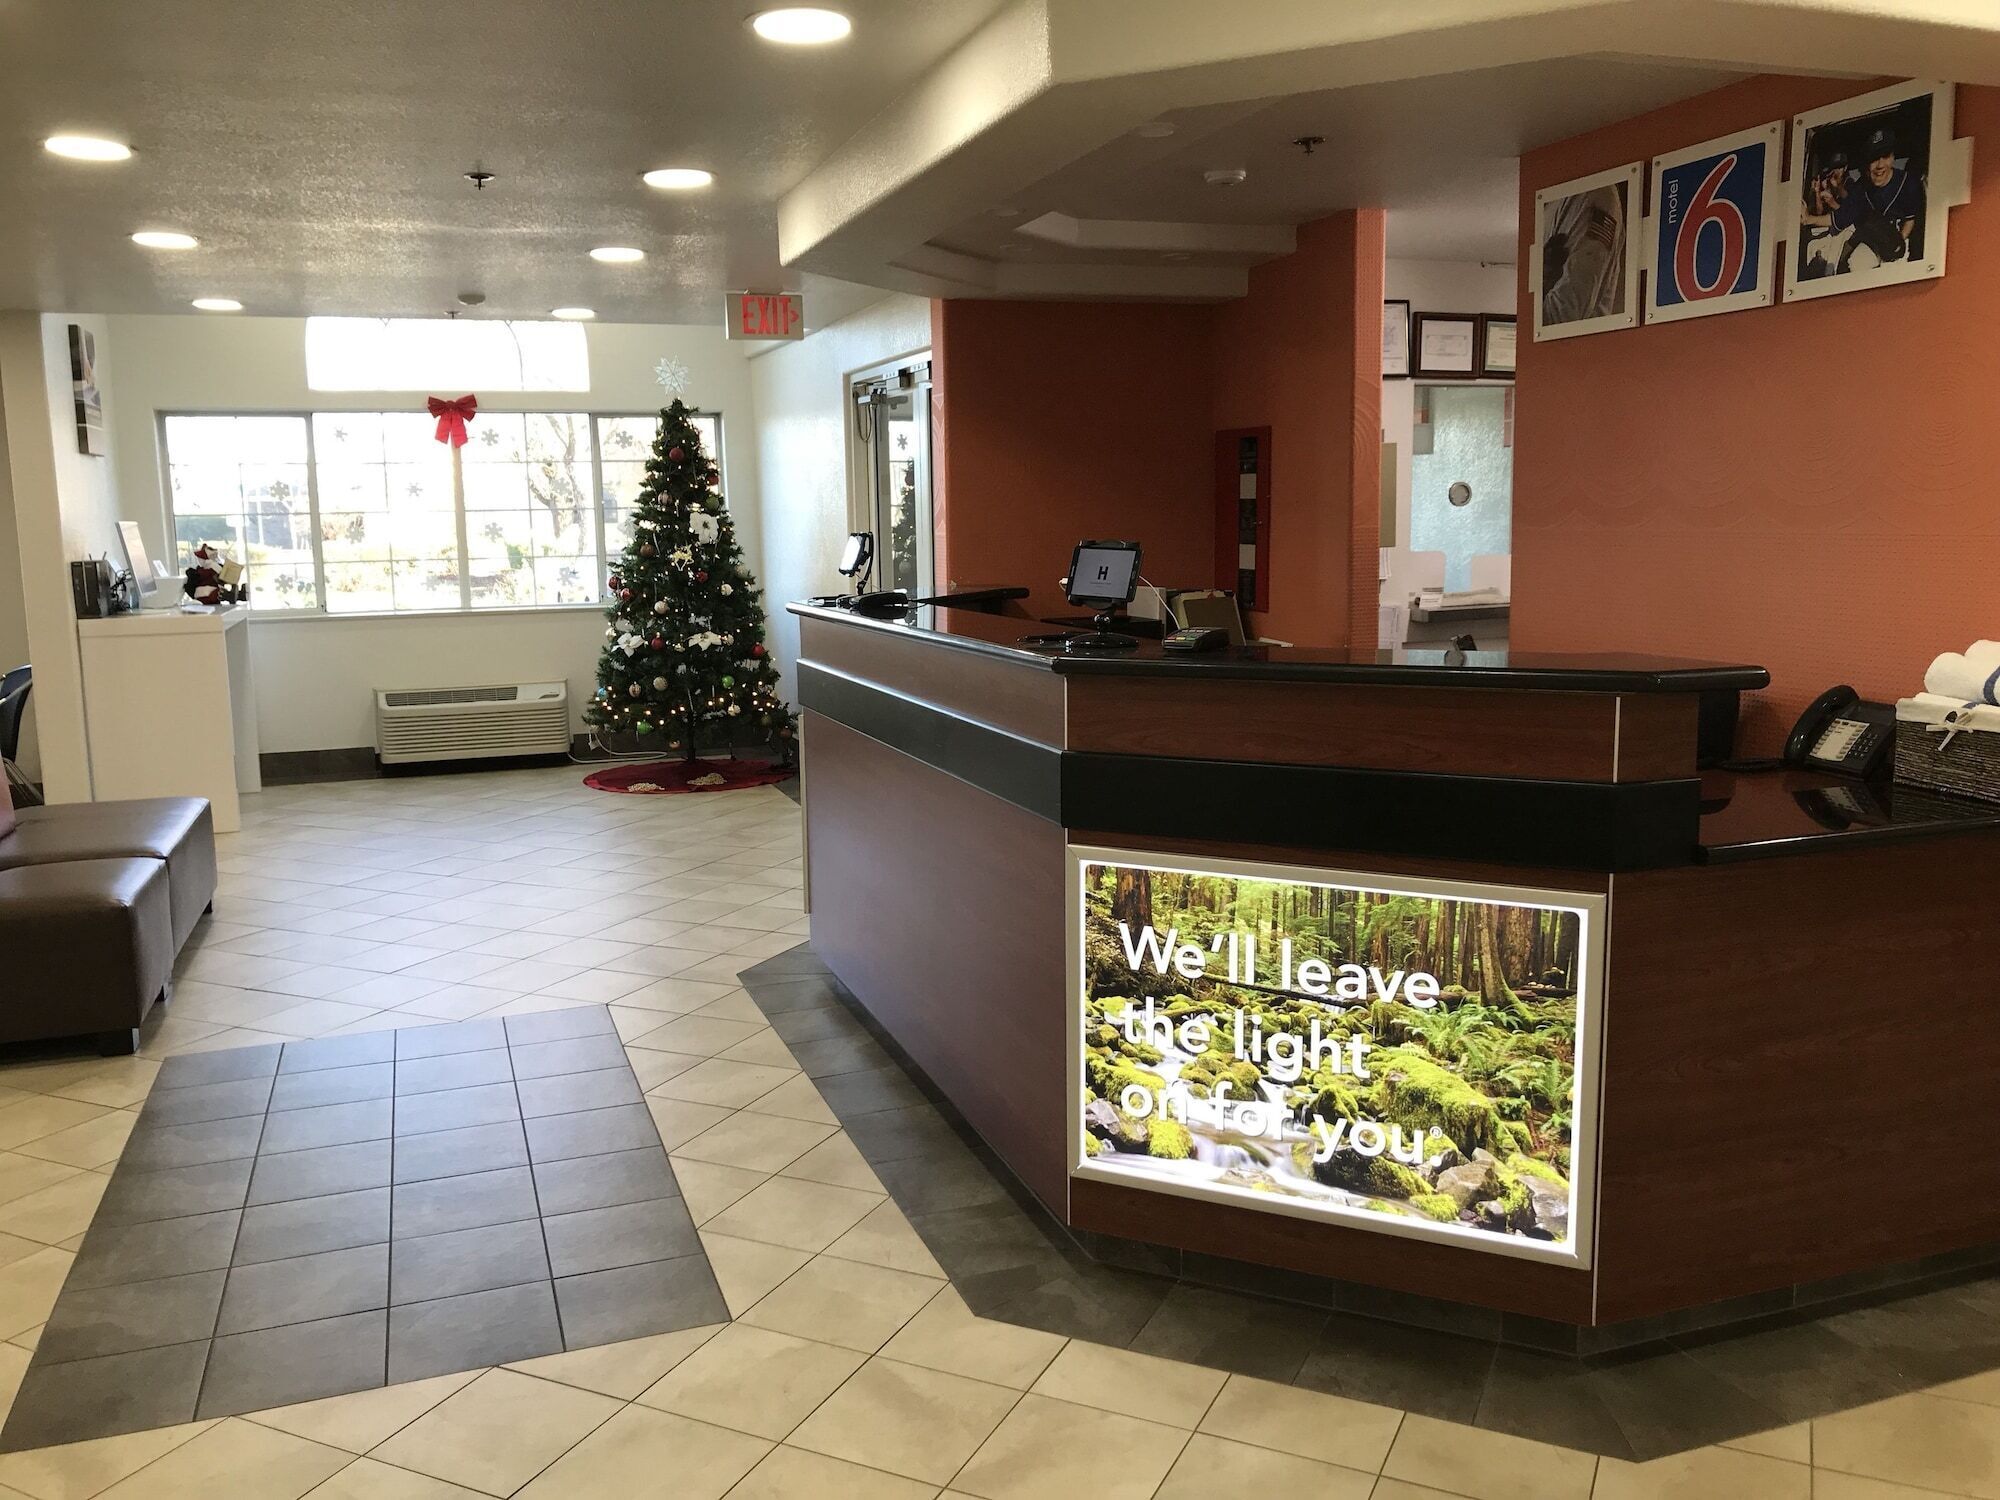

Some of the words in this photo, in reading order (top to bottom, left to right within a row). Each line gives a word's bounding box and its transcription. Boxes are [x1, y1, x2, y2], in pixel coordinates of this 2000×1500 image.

[1668, 178, 1679, 224] motel
[1673, 153, 1747, 302] 6
[741, 295, 791, 335] EXIT
[1097, 565, 1109, 581] H
[1119, 921, 1256, 986] We'll
[1281, 938, 1441, 1009] leave
[1120, 996, 1211, 1054] the
[1234, 1008, 1371, 1082] light
[1120, 1081, 1188, 1125] on
[1212, 1080, 1295, 1141] for
